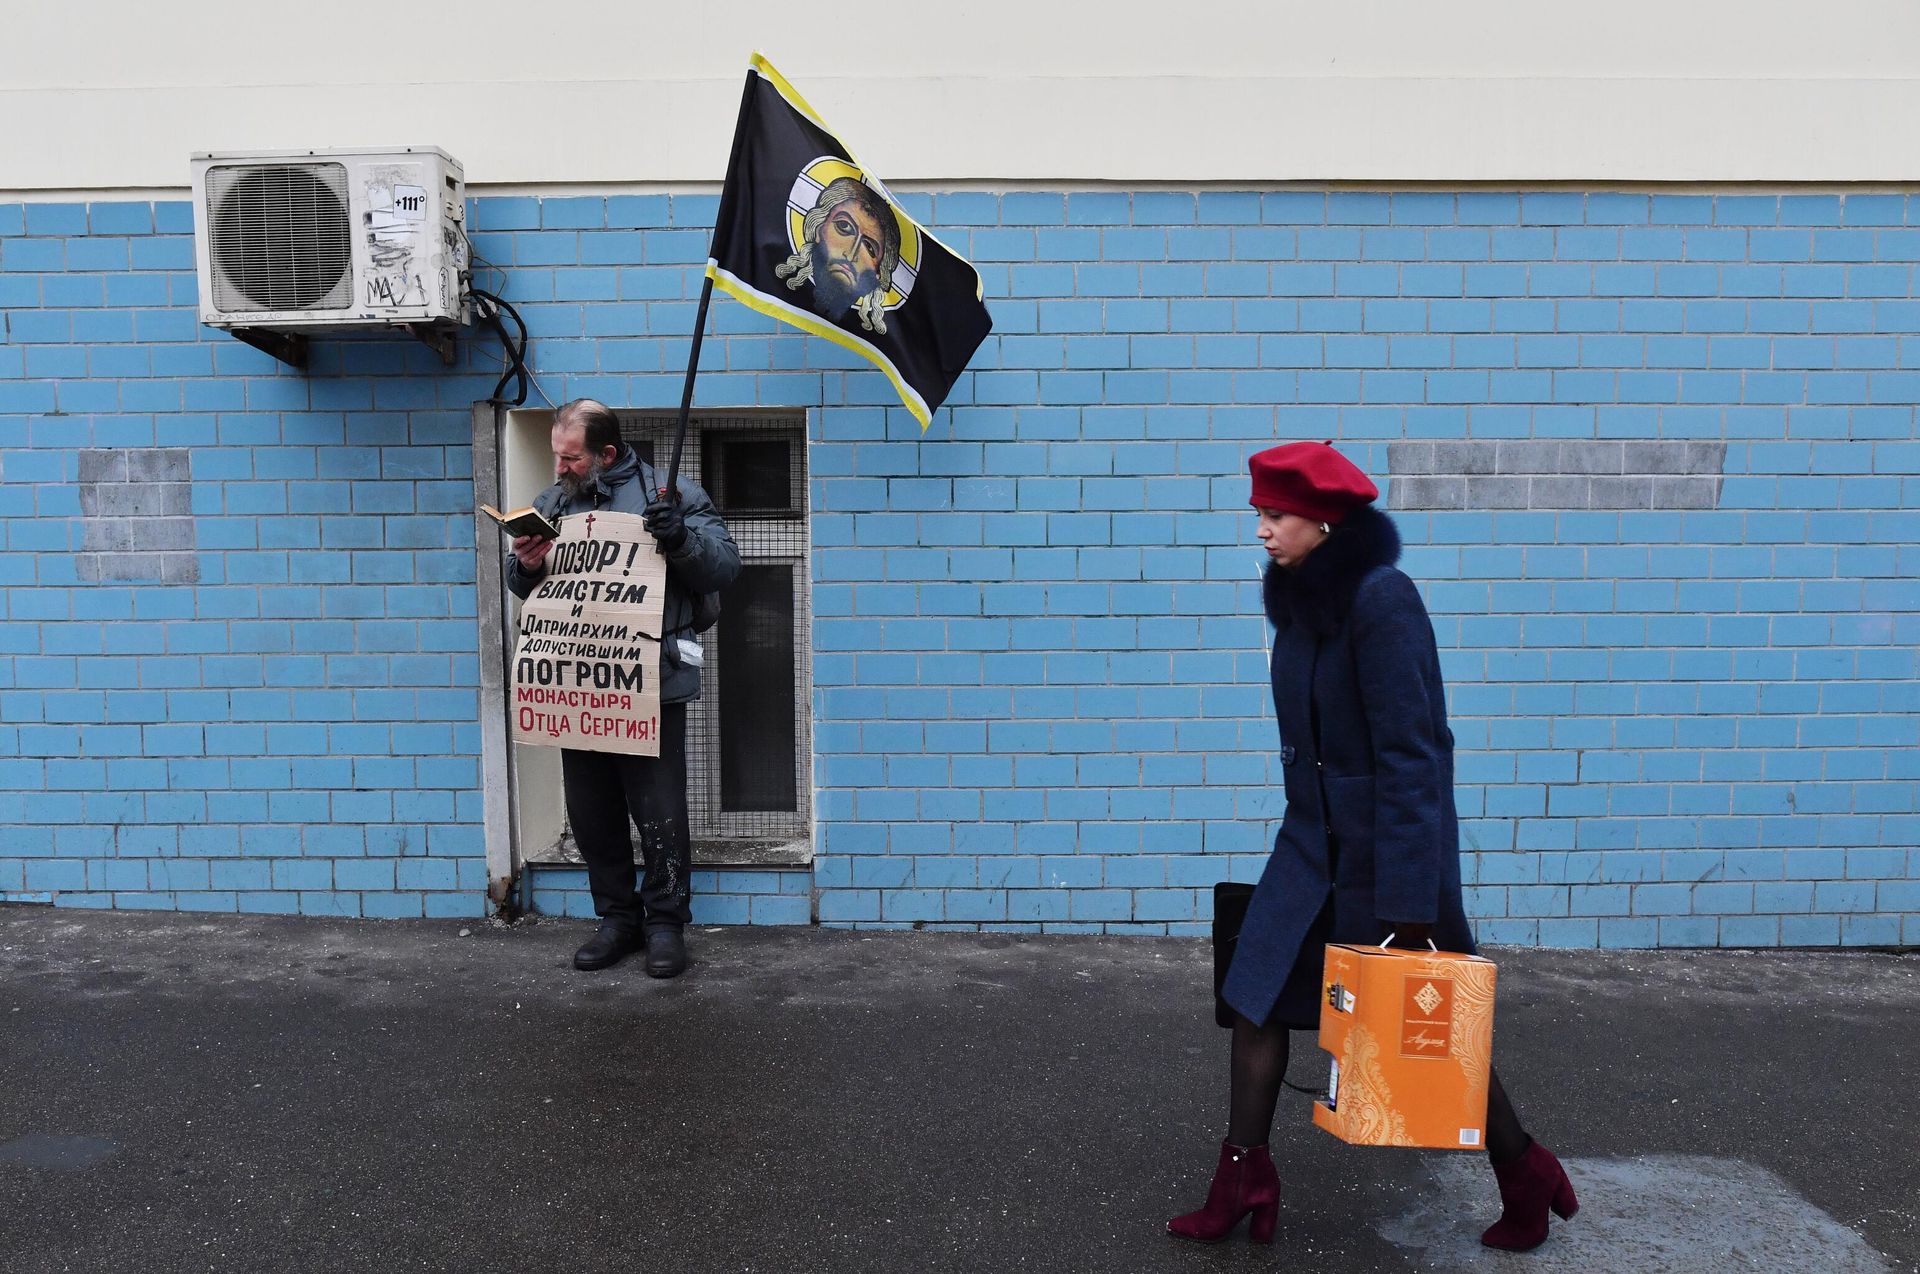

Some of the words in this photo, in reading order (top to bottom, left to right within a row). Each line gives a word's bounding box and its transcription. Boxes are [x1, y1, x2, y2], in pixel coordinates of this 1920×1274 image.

[537, 580, 648, 604] ВЛАСТЯМ
[571, 604, 583, 618] И
[521, 639, 641, 661] ДОПУСТИВШИМ
[517, 658, 643, 693] ПОГРОМ
[517, 688, 632, 710] МОНАСТЫРЯ
[519, 707, 571, 737] ОТЦА
[580, 712, 657, 740] СЕРГИЯ!
